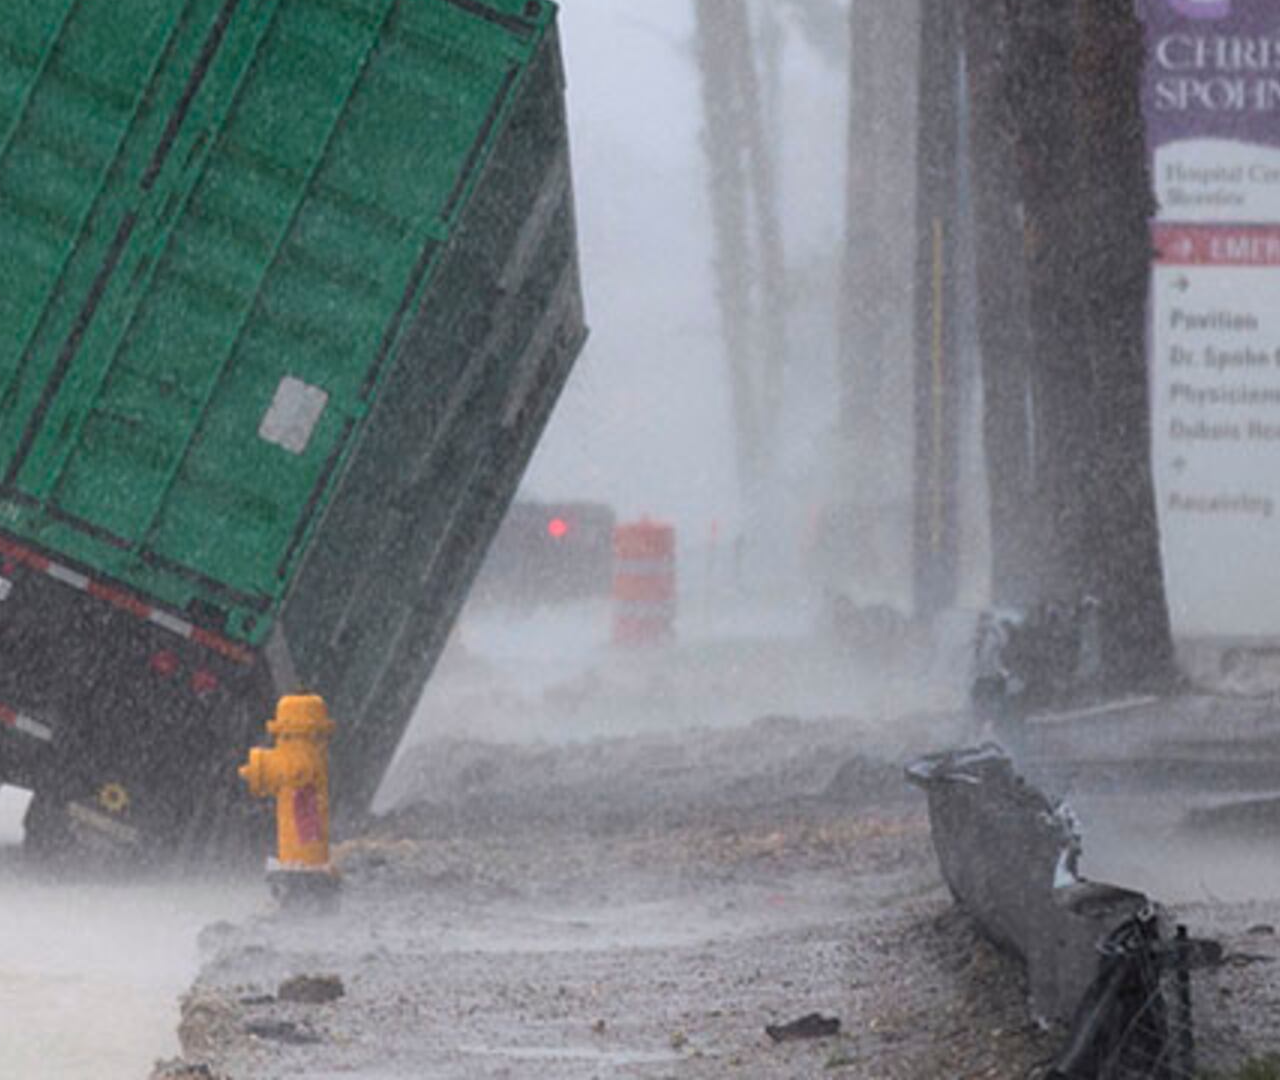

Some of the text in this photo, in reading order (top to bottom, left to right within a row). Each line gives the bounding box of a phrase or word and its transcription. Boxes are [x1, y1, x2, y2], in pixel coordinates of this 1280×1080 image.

[1166, 163, 1243, 186] Hospital
[1170, 307, 1259, 332] Pavilion
[1203, 345, 1269, 371] Spohn
